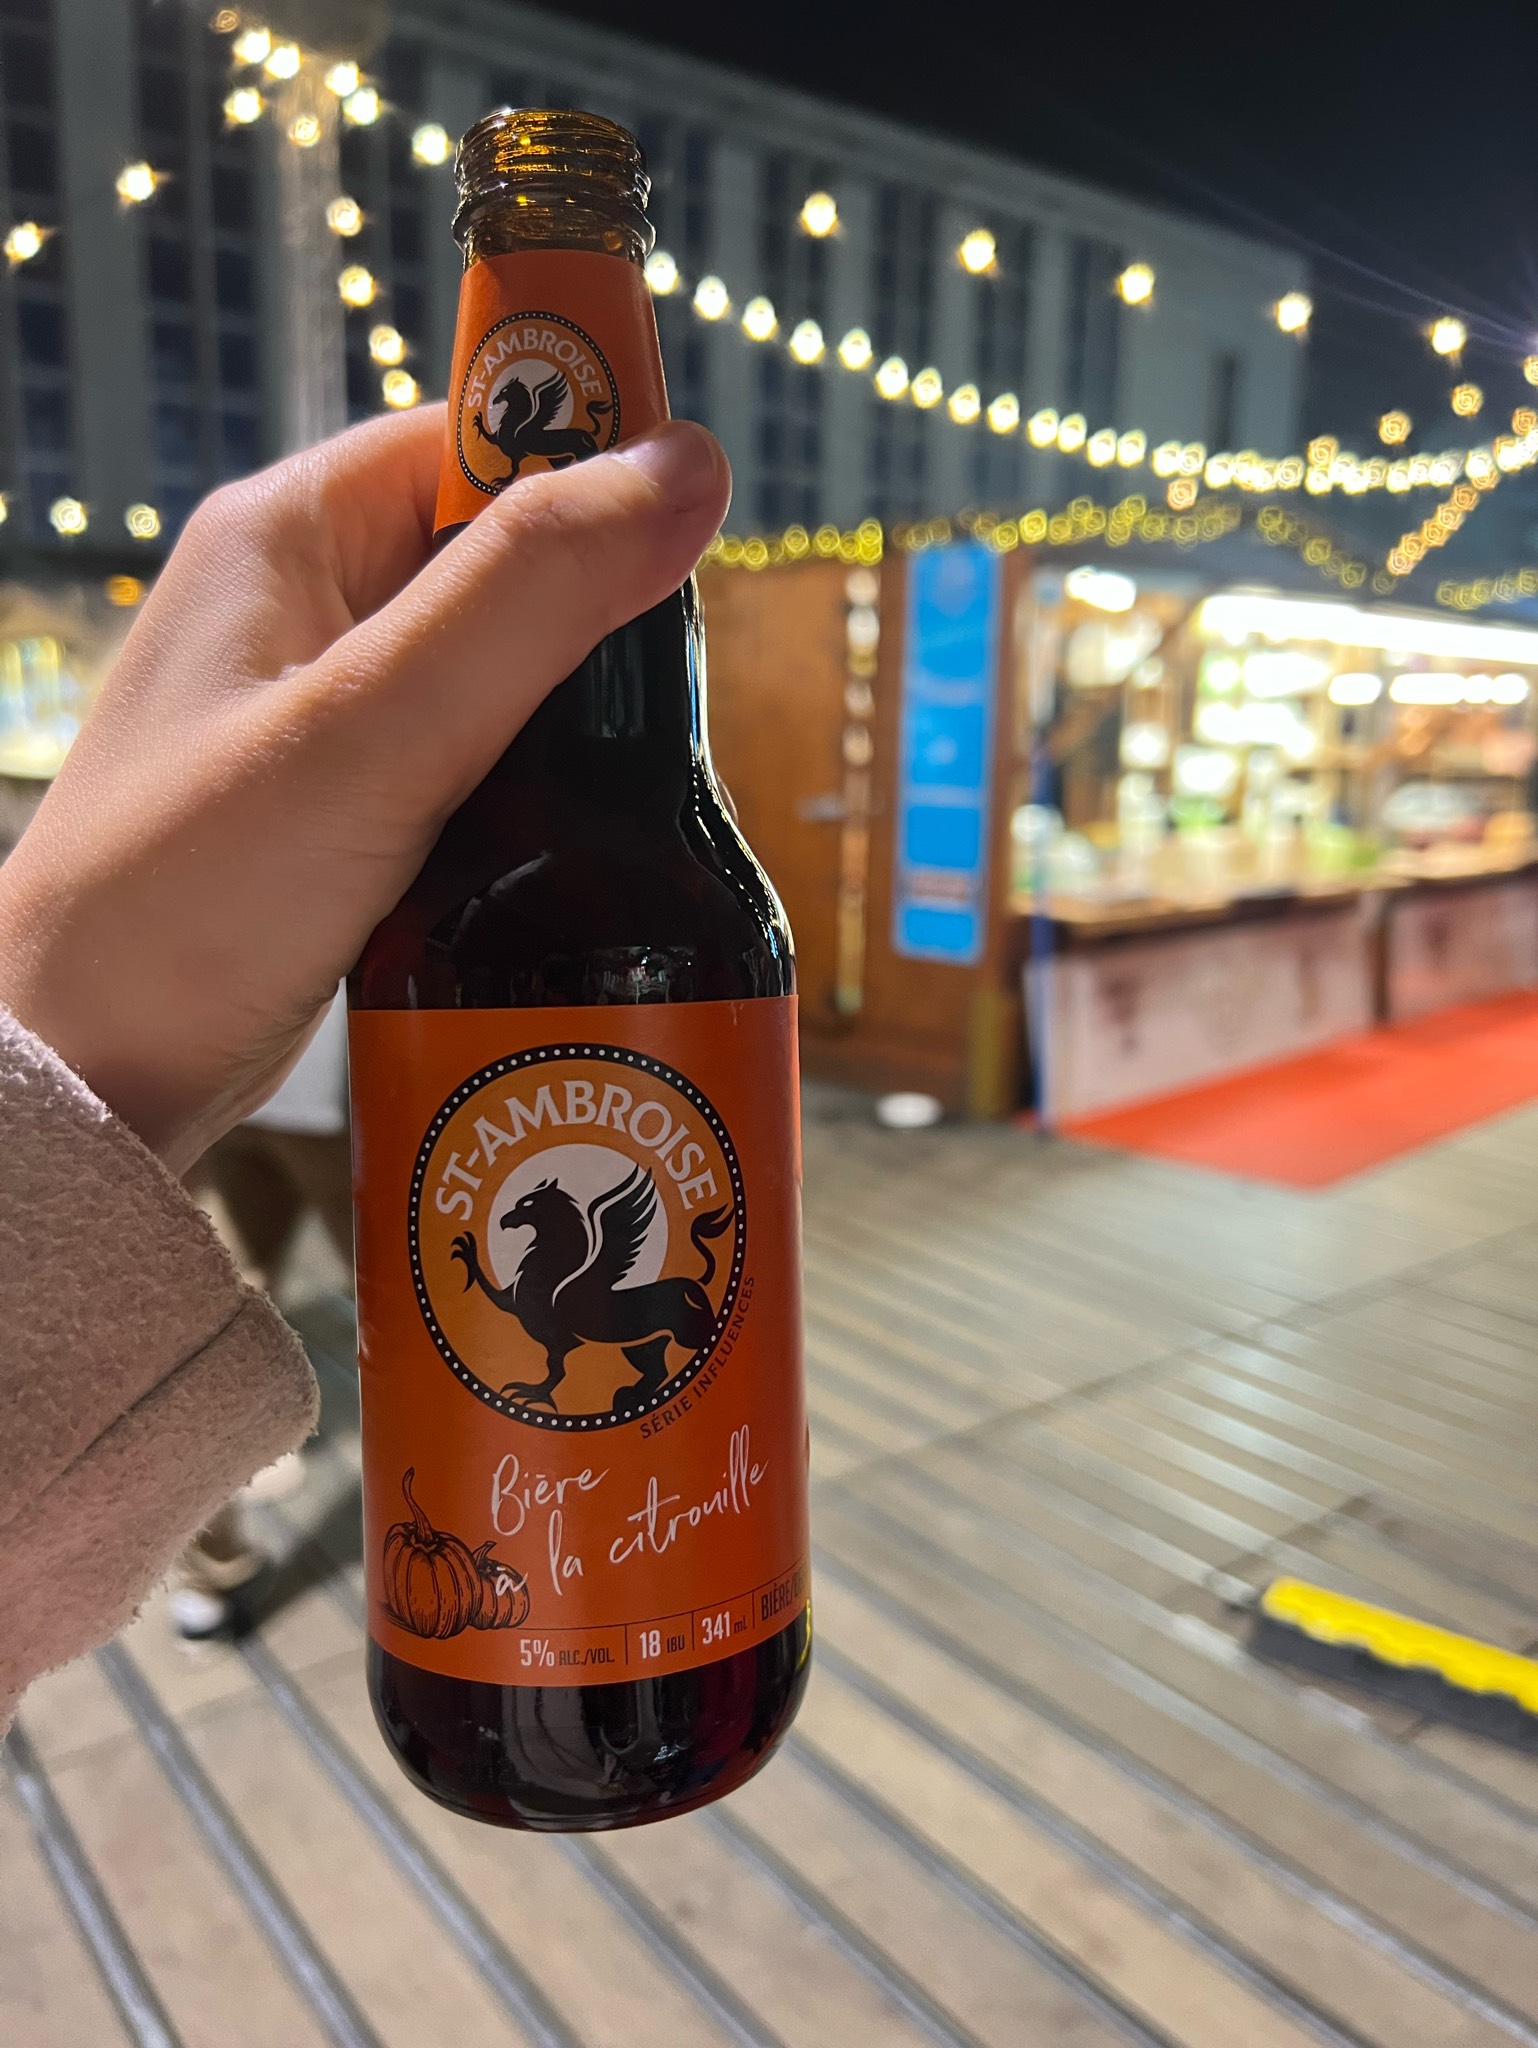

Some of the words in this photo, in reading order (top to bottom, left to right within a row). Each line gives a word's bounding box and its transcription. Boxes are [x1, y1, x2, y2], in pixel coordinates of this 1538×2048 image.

[467, 327, 604, 409] ST-AMBROISE
[435, 1079, 719, 1221] ST-AMBROISE
[640, 1395, 693, 1439] SÉRIE
[692, 1276, 755, 1398] INFLUENCES
[491, 1453, 610, 1536] Bière
[548, 1509, 584, 1596] la
[608, 1423, 770, 1564] citrouille
[520, 1638, 555, 1667] 5%
[639, 1629, 661, 1659] 18
[667, 1635, 685, 1654] IBU
[702, 1611, 731, 1645] 341
